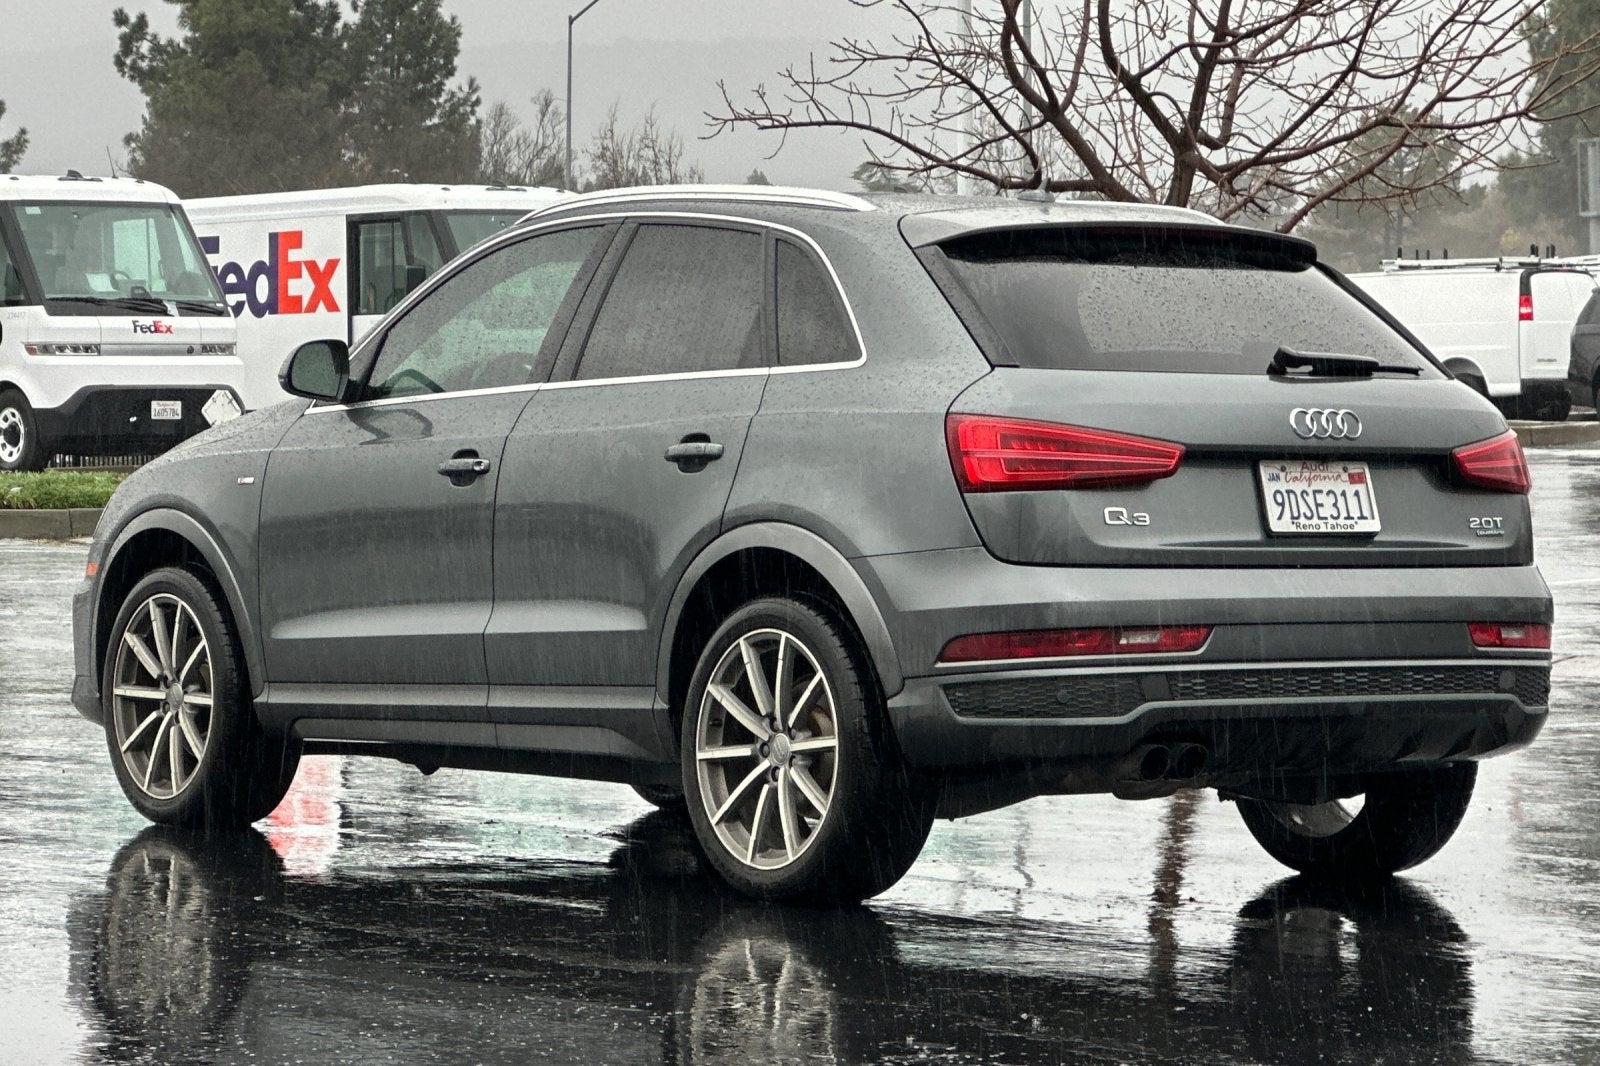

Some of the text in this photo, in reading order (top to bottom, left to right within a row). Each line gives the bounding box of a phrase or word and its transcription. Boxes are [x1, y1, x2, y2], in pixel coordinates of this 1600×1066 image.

[131, 319, 173, 334] FedEx
[1301, 461, 1330, 472] Audi
[1267, 472, 1281, 482] JAN
[1284, 472, 1346, 487] California
[1273, 489, 1369, 520] 9DSE311
[1103, 506, 1151, 526] Q3
[1295, 521, 1356, 531] Reno Tahoe
